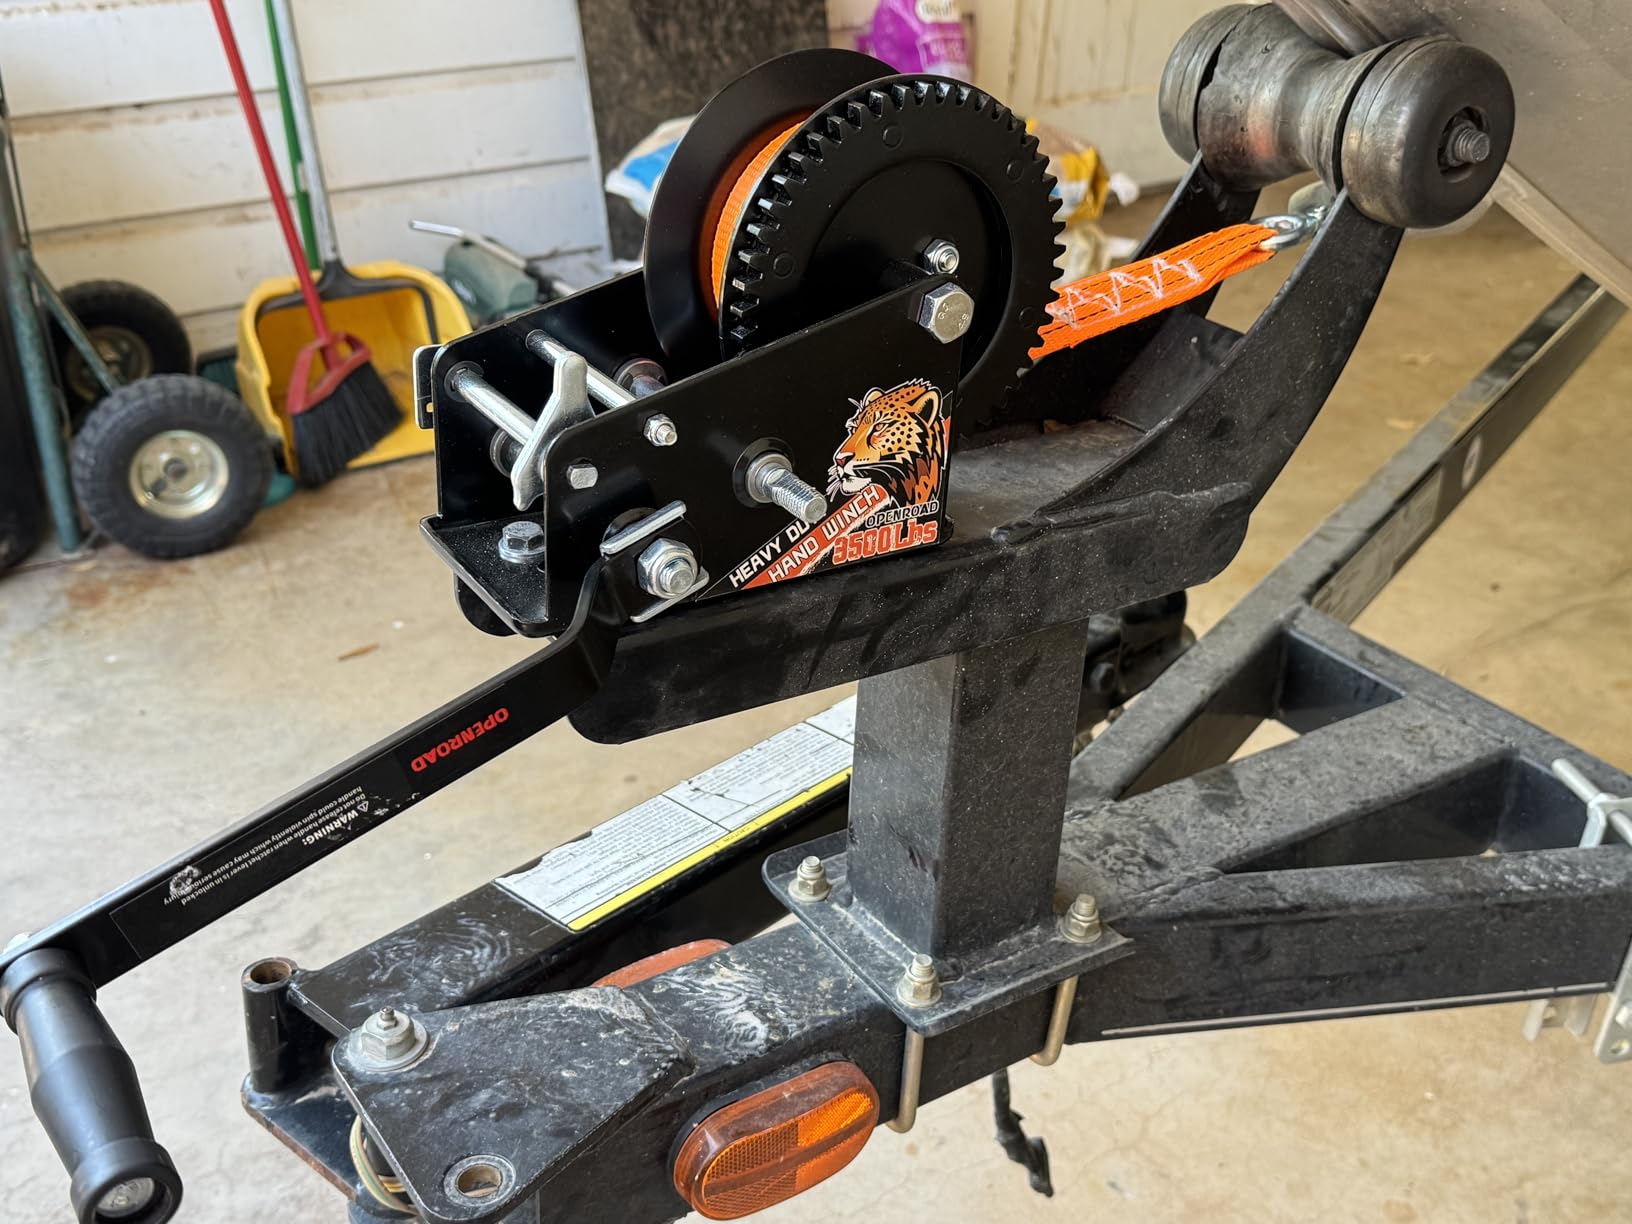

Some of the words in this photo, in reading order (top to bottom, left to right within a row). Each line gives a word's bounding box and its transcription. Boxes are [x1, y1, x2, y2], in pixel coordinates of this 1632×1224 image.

[865, 500, 939, 527] OPENROAD
[767, 536, 819, 583] HAND
[821, 485, 880, 539] WINCH
[728, 537, 783, 588] HEAVY
[411, 707, 509, 772] OPENROAD
[337, 786, 363, 803] handle
[317, 800, 338, 816] could
[342, 799, 356, 810] not
[301, 812, 318, 824] spin
[318, 806, 344, 824] release
[271, 821, 303, 842] violently
[293, 821, 319, 839] handle
[301, 809, 359, 846] WARNING:
[249, 839, 272, 855] which
[273, 835, 294, 850] when
[233, 852, 250, 864] may
[247, 847, 274, 866] ratchet
[212, 861, 234, 876] cause
[230, 862, 249, 876] lever
[180, 881, 215, 906] unlocked
